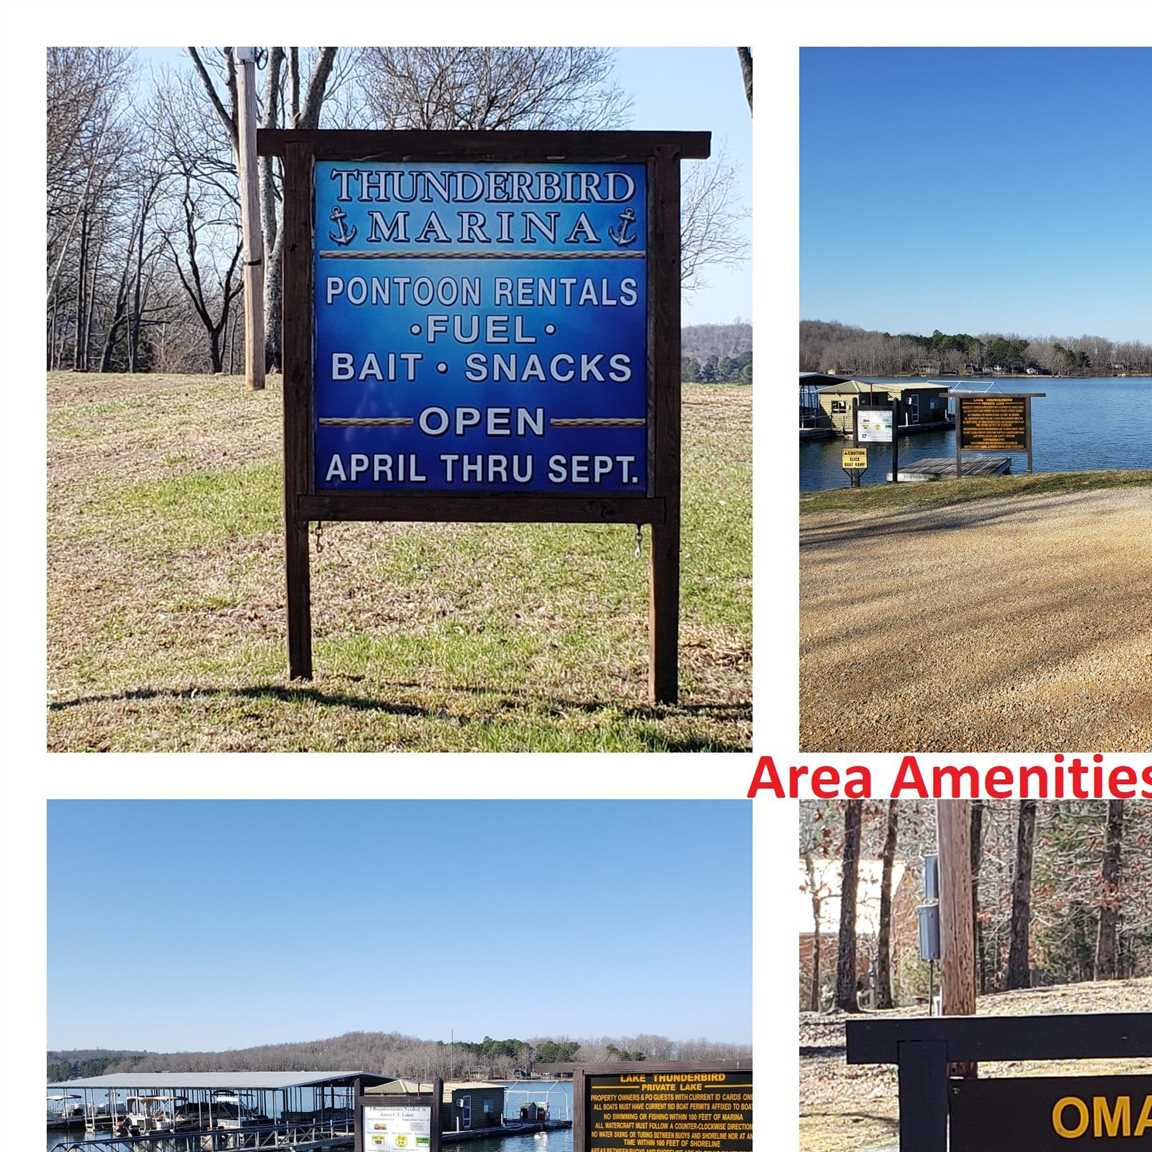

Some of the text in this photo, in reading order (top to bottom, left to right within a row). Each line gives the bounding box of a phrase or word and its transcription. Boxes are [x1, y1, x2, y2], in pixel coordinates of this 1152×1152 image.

[330, 169, 635, 203] THUNDERBIRD
[367, 211, 600, 243] MARINA
[326, 276, 639, 307] PONTOON RENTALS
[331, 352, 633, 382] BAIT SNACKS
[418, 407, 545, 436] OPEN
[325, 454, 639, 484] APRIL THRU SEPT.
[620, 1073, 726, 1083] LAKE THUNDERBIRD
[680, 1083, 703, 1091] LAKE
